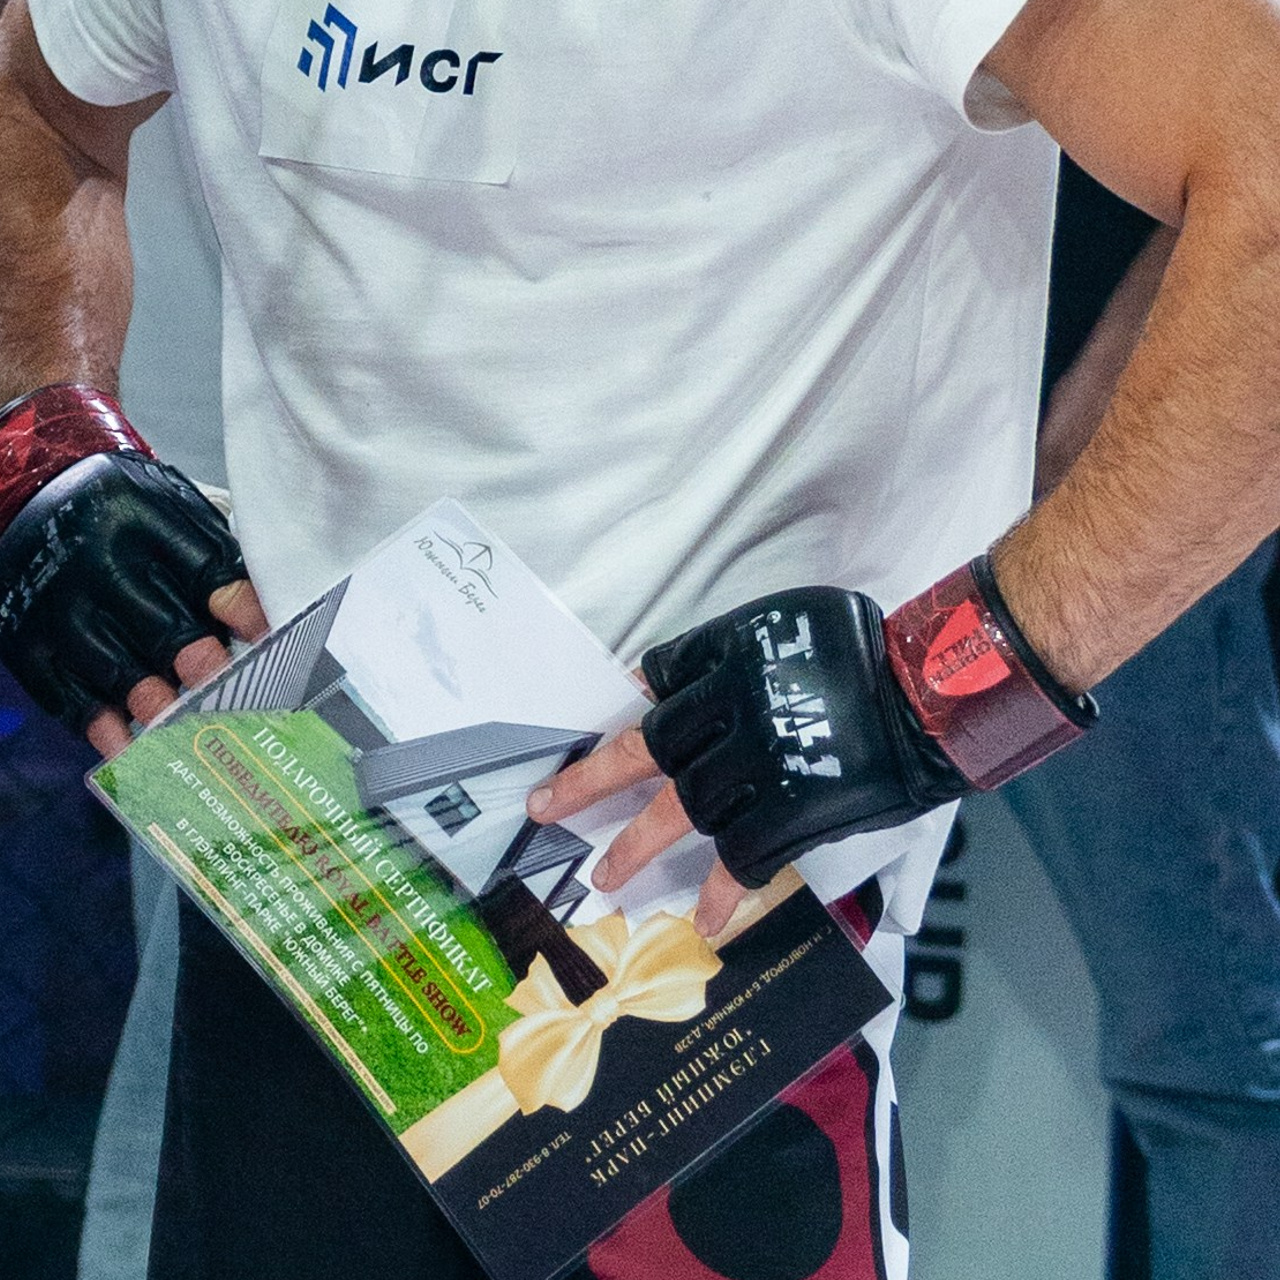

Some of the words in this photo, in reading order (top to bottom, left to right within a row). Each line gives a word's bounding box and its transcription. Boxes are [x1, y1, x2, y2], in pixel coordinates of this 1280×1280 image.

[167, 759, 202, 790] ДАЕТ
[199, 789, 282, 878] ВОЗМОЖНОСТЬ
[278, 877, 355, 961] ПРОЖИВАНИЯ
[350, 958, 364, 972] С
[358, 971, 414, 1034] ПЯТНИЦЫ
[409, 1031, 429, 1054] ПО
[176, 818, 189, 831] В
[185, 829, 281, 932] ГЛЭМПИНГ-ПАРКЕ
[205, 736, 318, 856] ПОБЕДИТЕЛЮ
[314, 855, 369, 916] ROYAL
[365, 913, 428, 984] BATTLE
[421, 981, 472, 1037] SHOW
[222, 842, 296, 923] ВОСКРЕСЕНЬЕ
[293, 922, 305, 934] В
[300, 933, 350, 983] ДОМИКЕ
[252, 727, 382, 861] ПОДАРОЧНЫЙ
[375, 859, 493, 993] СЕРТИФИКАТ
[477, 1148, 550, 1209] 8-930-287-70-07
[548, 1130, 571, 1151] ТЕЛ.
[589, 1038, 772, 1187] ГЛЭМПИНГ-ПАРК
